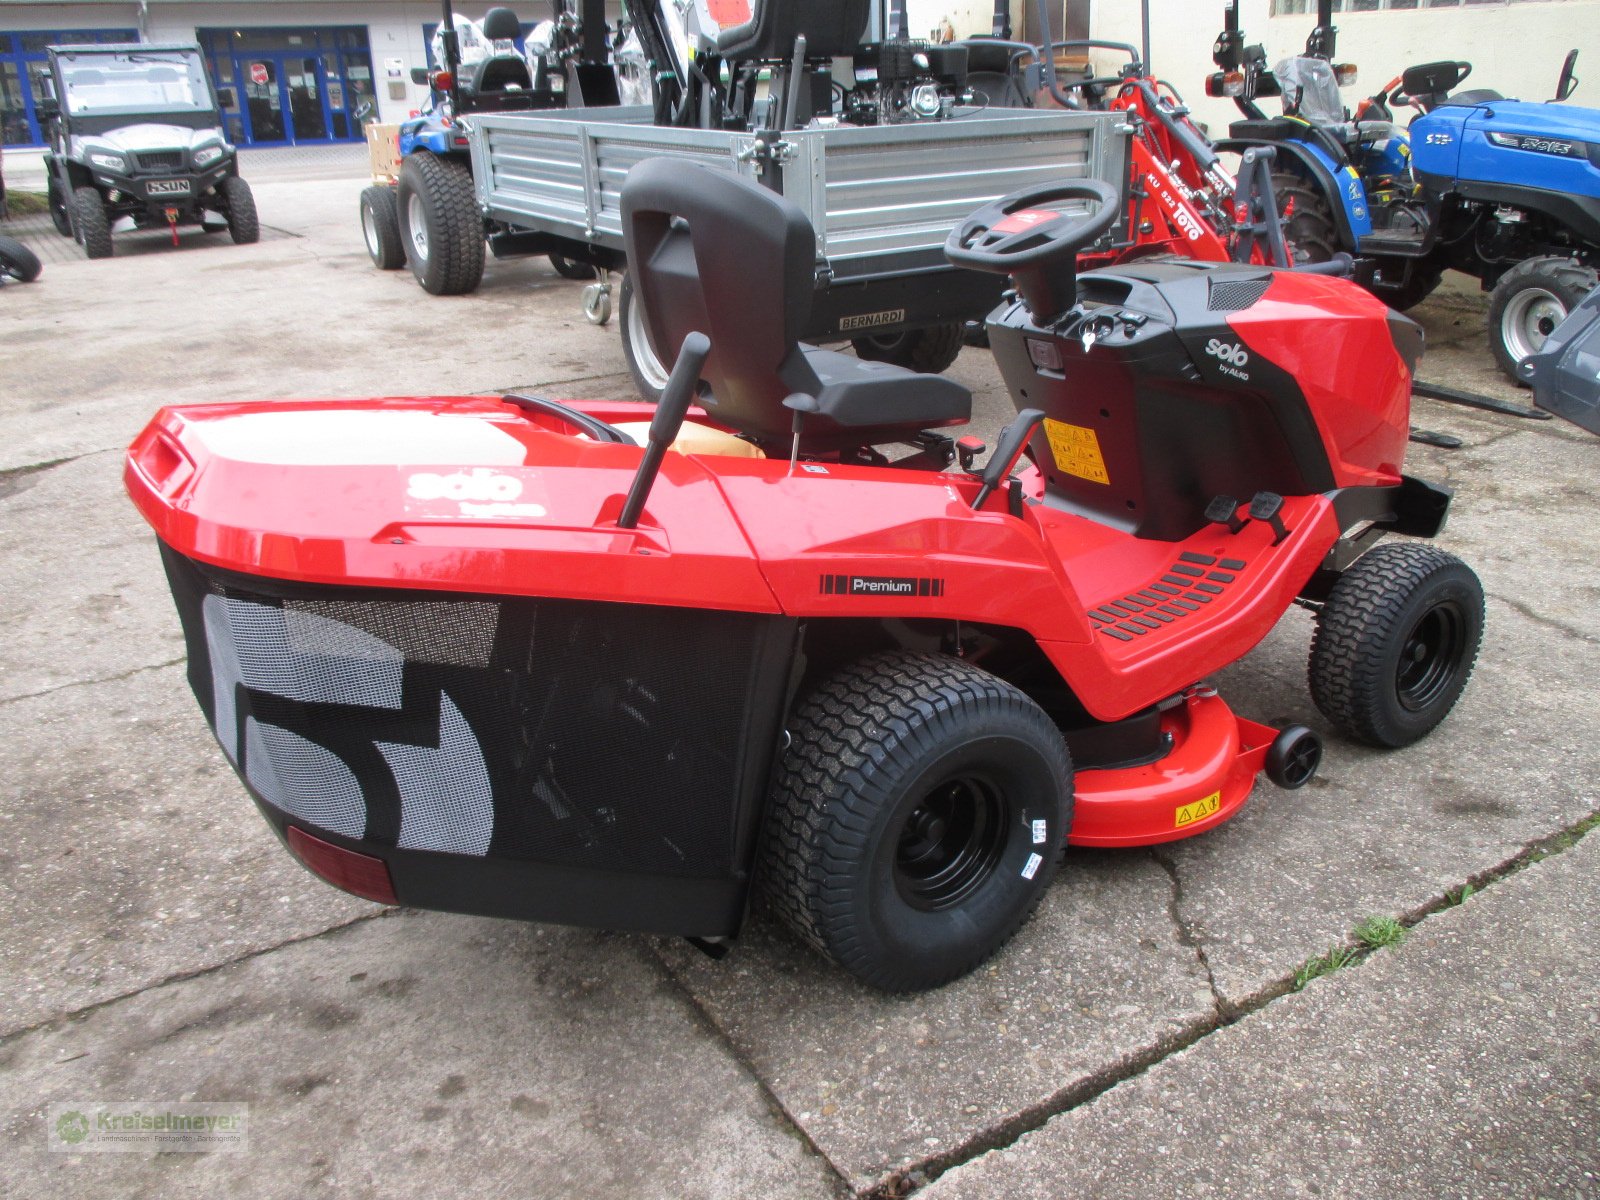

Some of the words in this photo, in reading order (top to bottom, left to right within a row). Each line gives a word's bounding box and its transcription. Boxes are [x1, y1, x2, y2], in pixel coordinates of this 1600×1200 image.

[1147, 173, 1160, 188] KU
[1161, 190, 1175, 208] 522
[1173, 202, 1204, 241] TOYO
[842, 311, 903, 329] BERNARDI
[1205, 338, 1248, 366] solo
[1219, 363, 1230, 374] by
[853, 578, 912, 592] Premium
